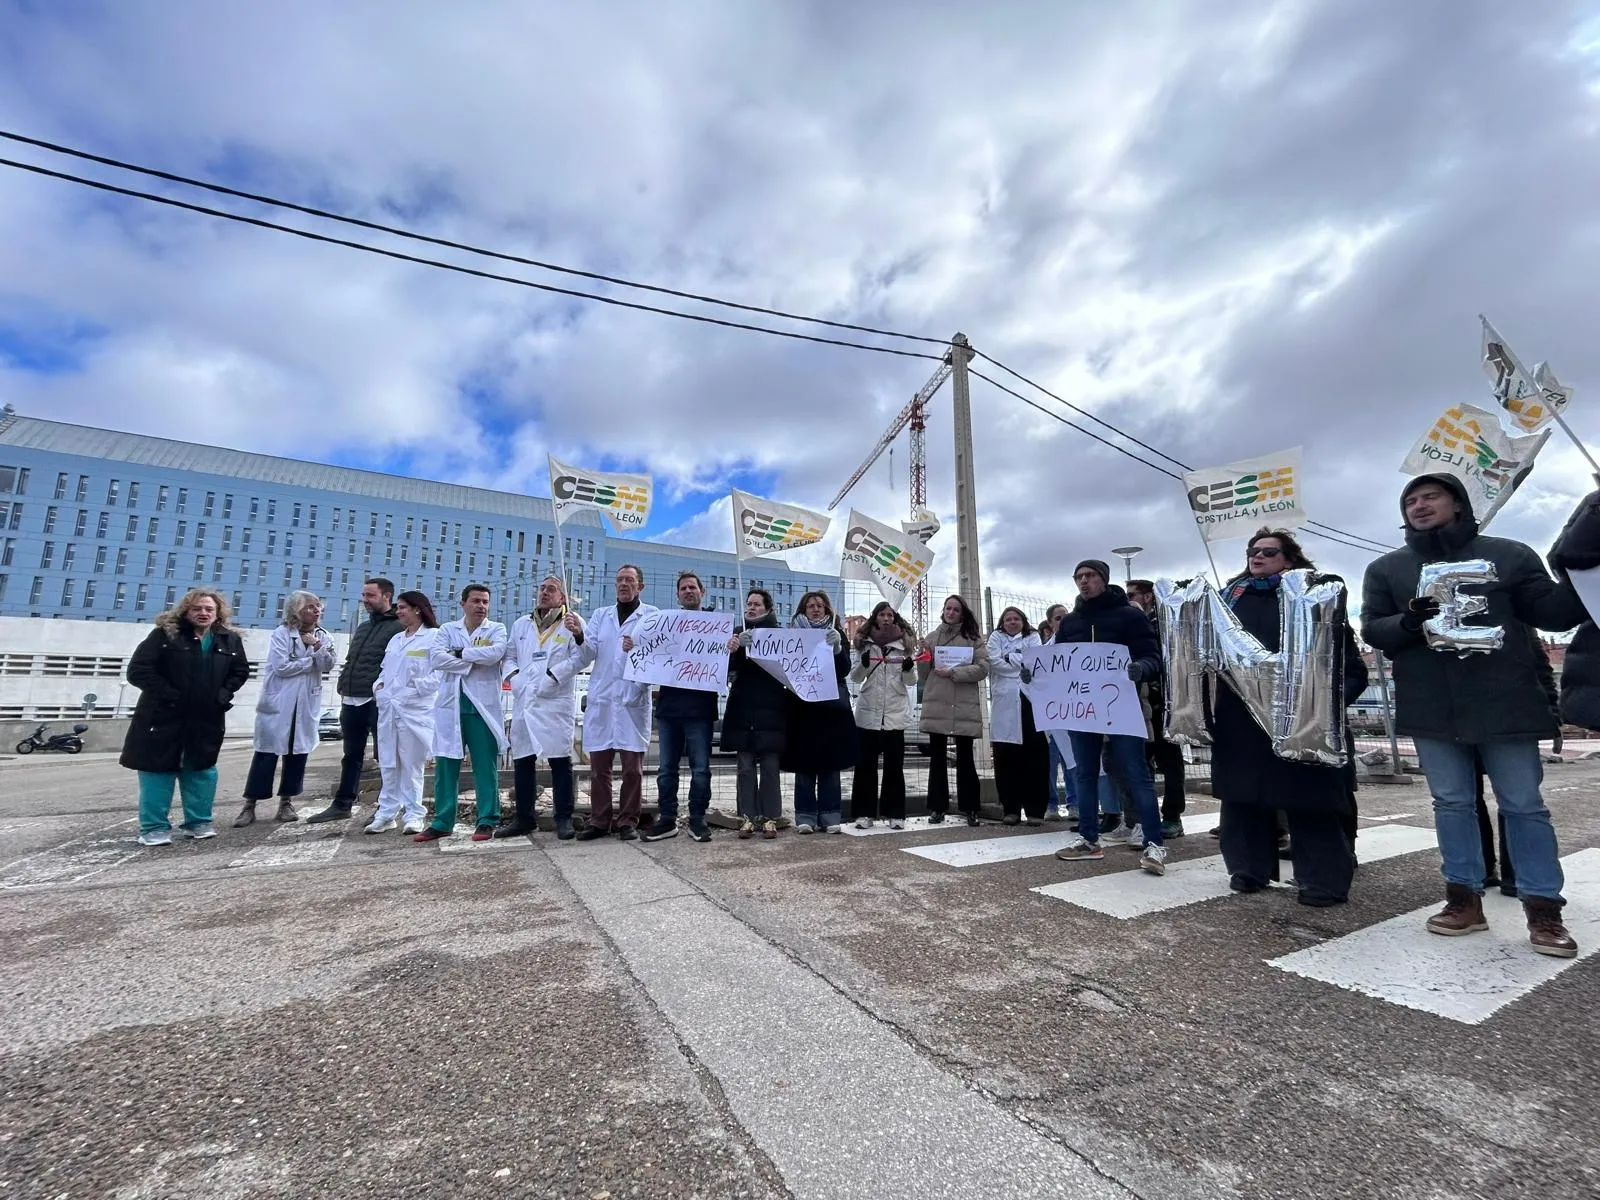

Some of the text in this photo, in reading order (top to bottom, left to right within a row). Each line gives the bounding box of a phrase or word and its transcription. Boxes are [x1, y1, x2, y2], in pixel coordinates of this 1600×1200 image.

[553, 475, 648, 513] CESM
[1187, 466, 1294, 513] CESM
[616, 512, 643, 525] LEÓN
[1196, 507, 1250, 525] CASTILLA
[1261, 499, 1296, 513] LEÓN
[741, 508, 820, 544] CESM
[844, 526, 926, 585] CESM
[642, 614, 679, 633] SIN
[685, 638, 705, 655] NO
[748, 633, 804, 657] MÓNICA
[673, 660, 721, 684] PARAR
[777, 656, 820, 676] DORA
[1032, 656, 1048, 678] A
[1051, 646, 1079, 673] MÍ
[1067, 681, 1090, 695] ME
[1045, 700, 1097, 720] CUIDA
